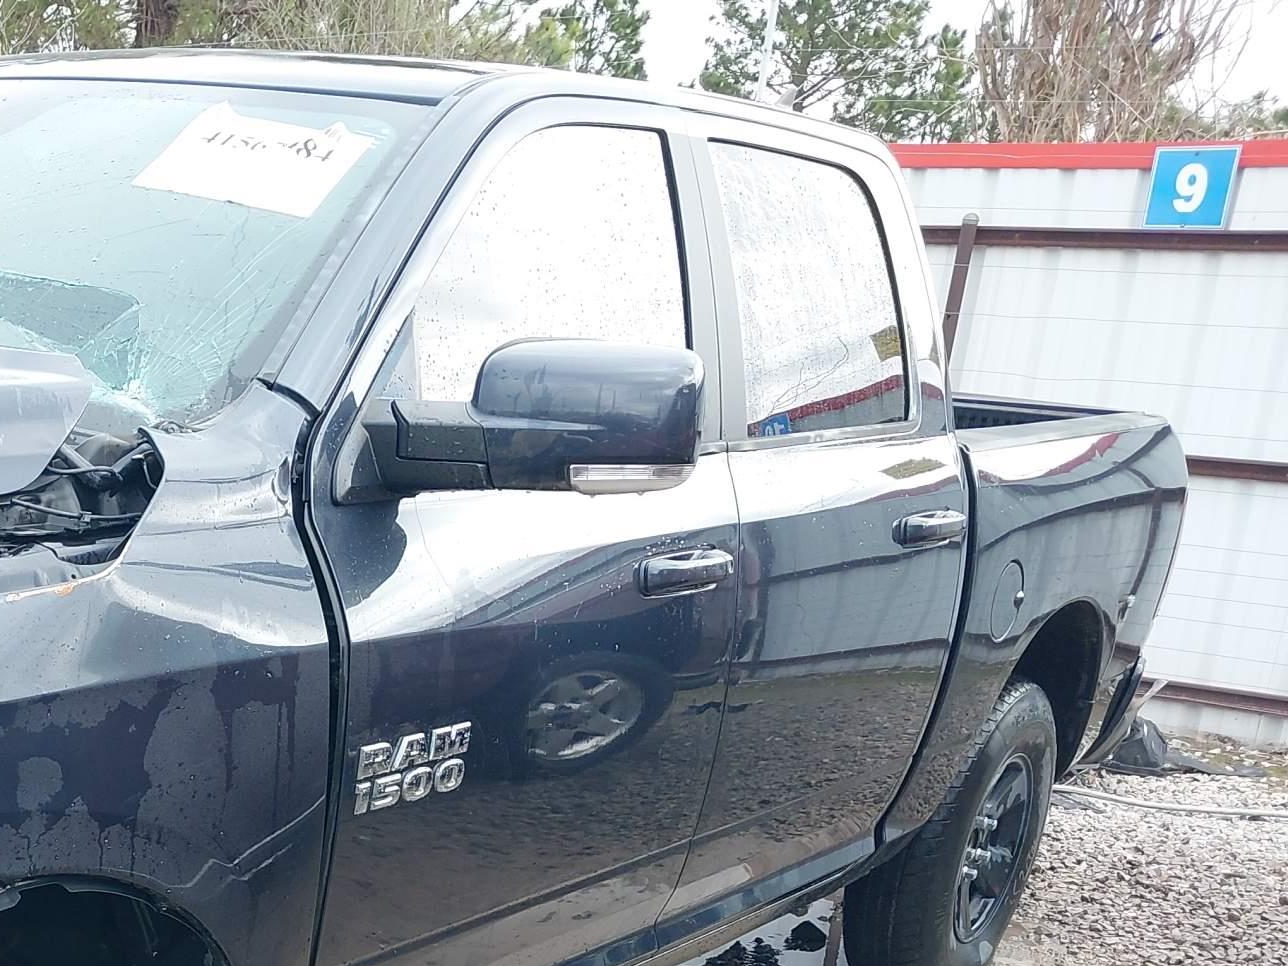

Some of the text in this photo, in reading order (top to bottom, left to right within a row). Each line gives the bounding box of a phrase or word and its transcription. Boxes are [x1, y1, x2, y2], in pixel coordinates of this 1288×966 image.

[1172, 163, 1208, 213] 9
[357, 721, 472, 780] RAM
[354, 758, 465, 815] 1500
